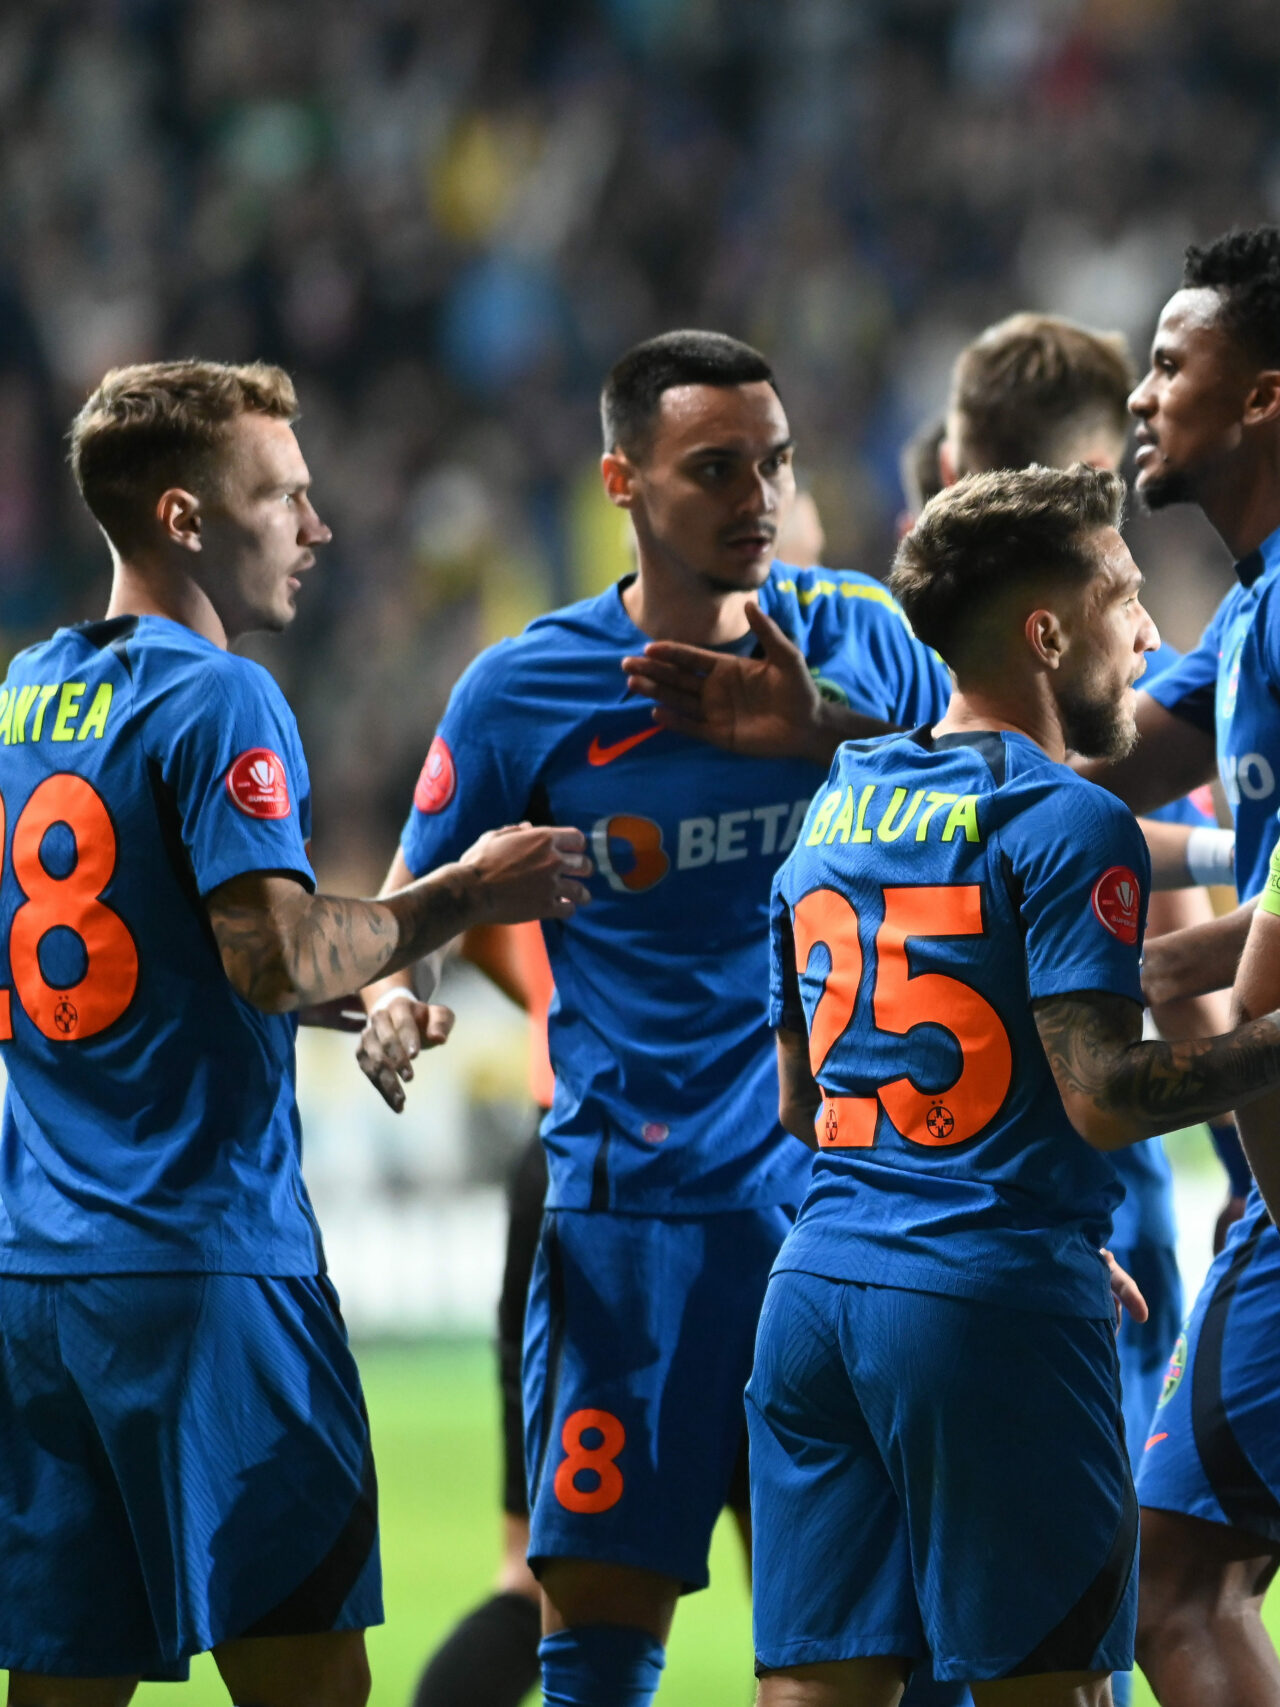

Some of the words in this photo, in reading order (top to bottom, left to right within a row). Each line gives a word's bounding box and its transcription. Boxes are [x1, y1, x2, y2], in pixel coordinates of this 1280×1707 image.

[0, 773, 139, 1042] 8
[805, 784, 981, 846] BALUTA
[792, 884, 1013, 1149] 25
[554, 1408, 625, 1514] 8
